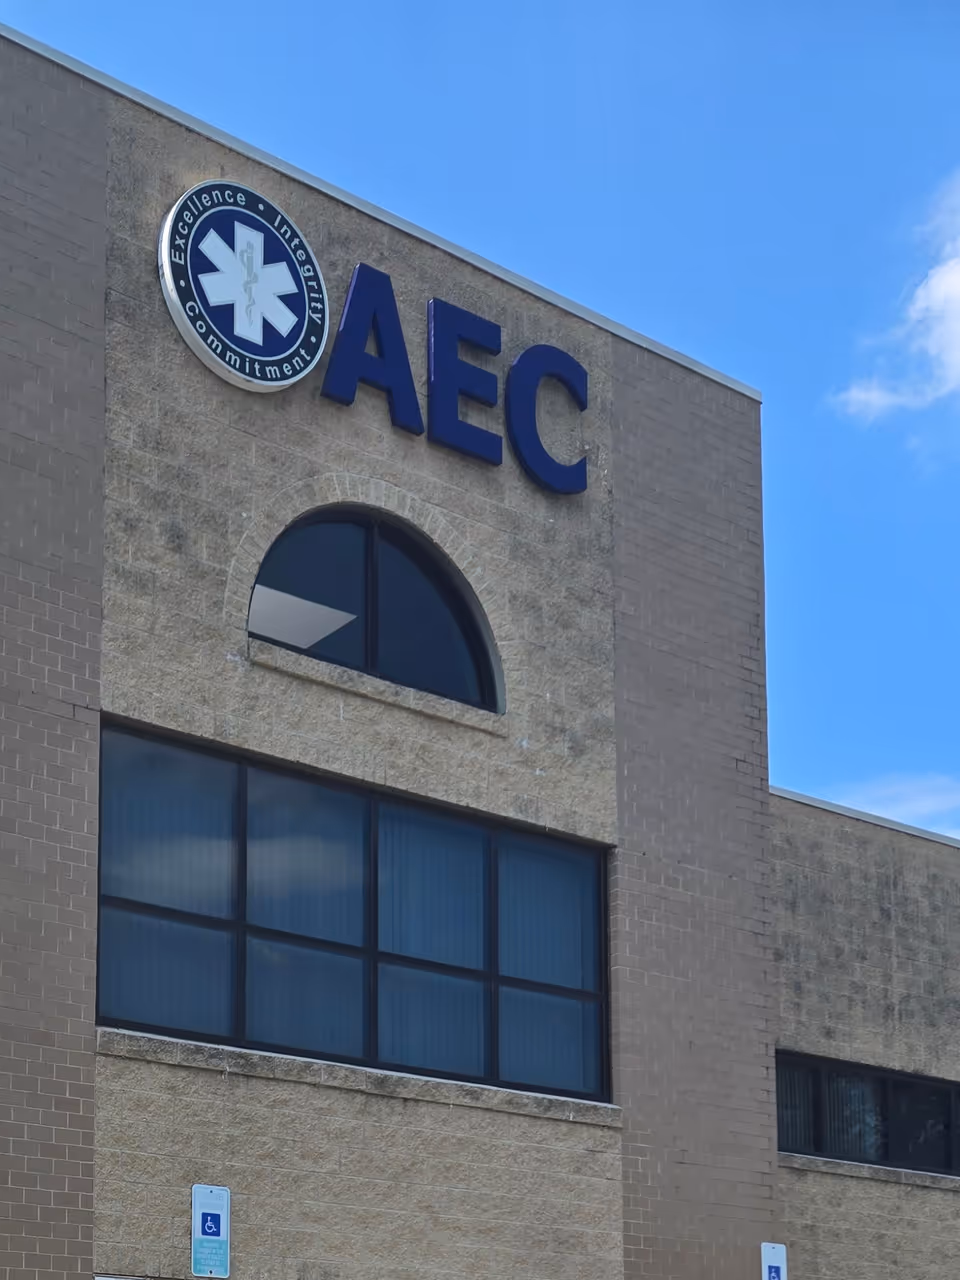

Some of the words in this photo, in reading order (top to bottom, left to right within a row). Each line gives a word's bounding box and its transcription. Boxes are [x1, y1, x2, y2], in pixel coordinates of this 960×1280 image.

[171, 189, 246, 265] Excellence
[273, 214, 323, 325] Integrity
[185, 301, 311, 379] Commitment
[319, 261, 588, 495] AEC
